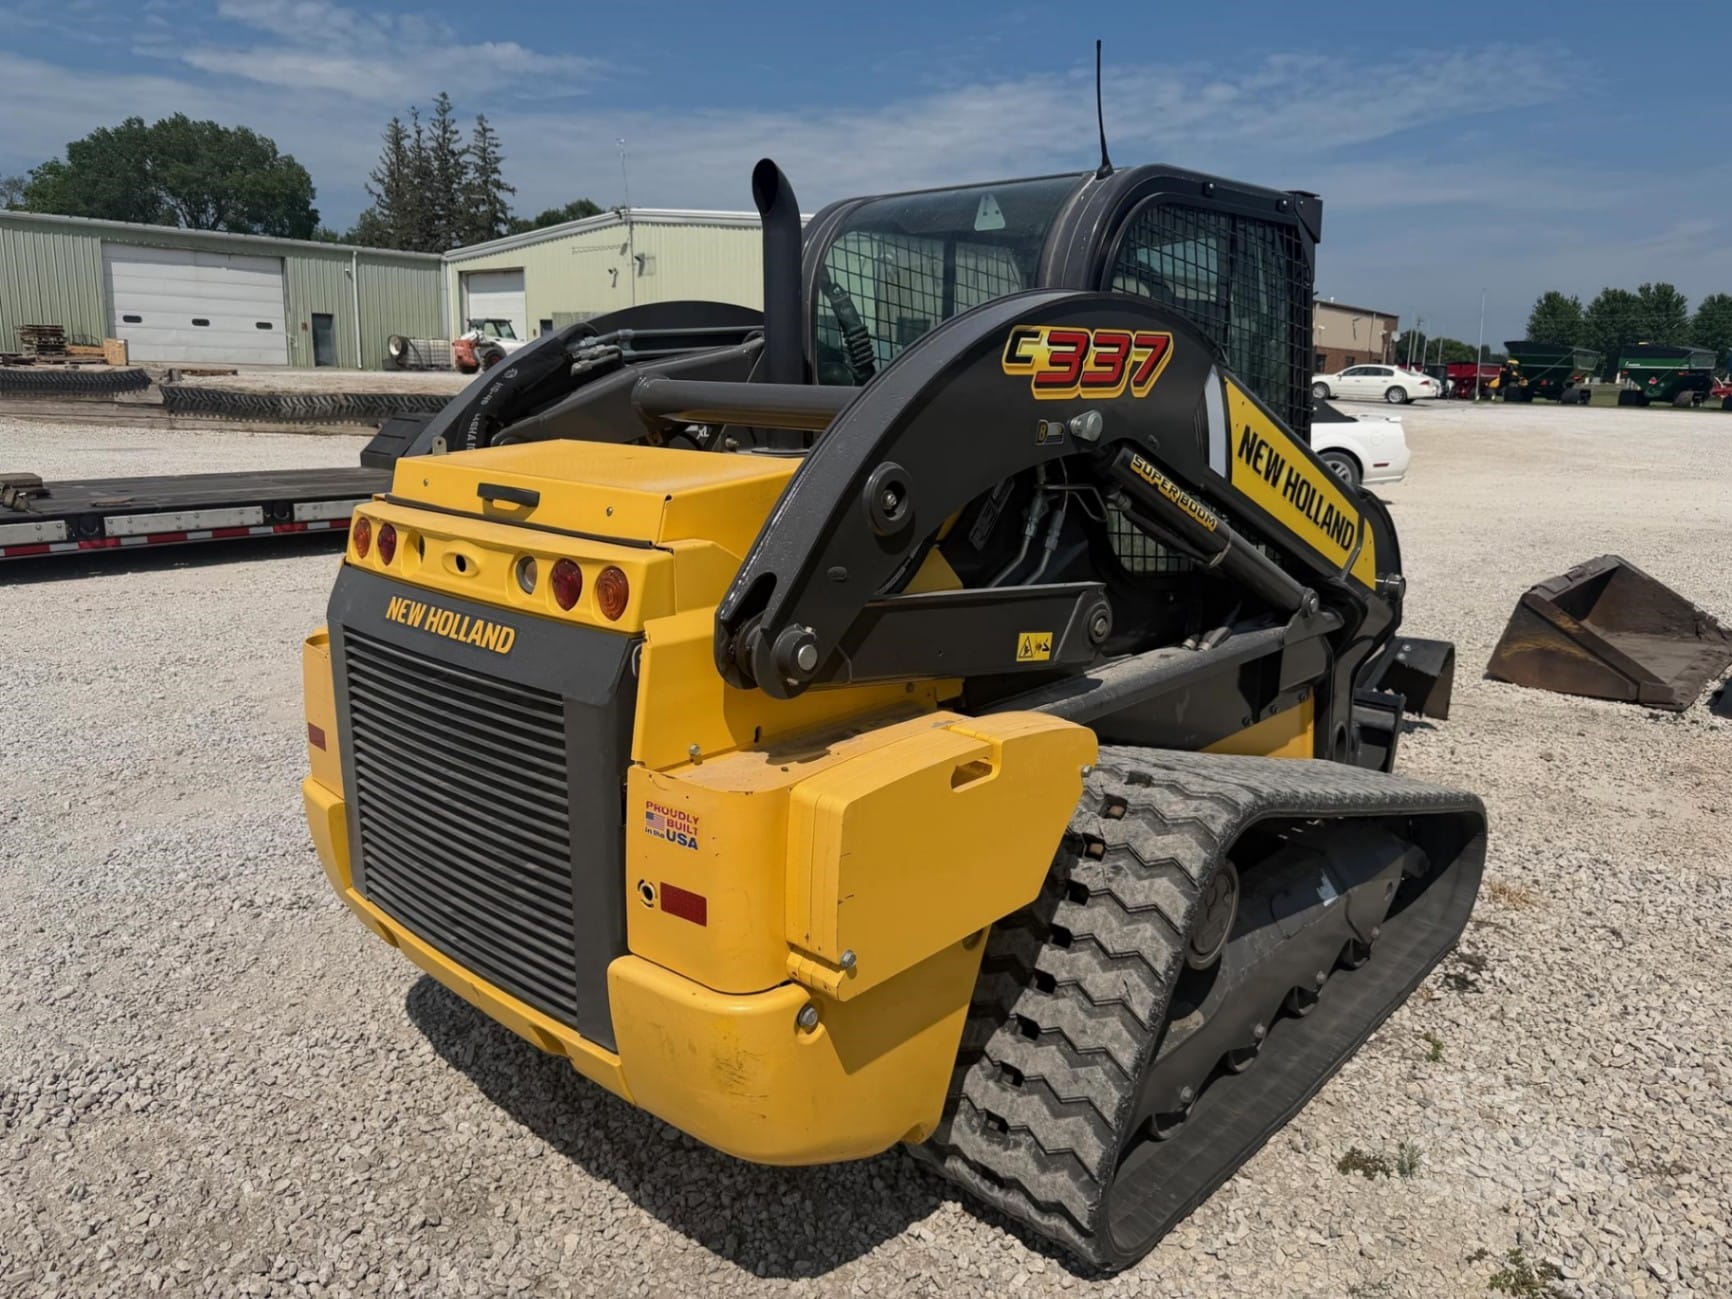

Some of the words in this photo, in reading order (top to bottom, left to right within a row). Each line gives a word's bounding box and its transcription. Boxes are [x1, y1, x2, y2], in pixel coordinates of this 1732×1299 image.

[1002, 326, 1173, 399] C337
[1131, 454, 1180, 502] SUPER
[1177, 490, 1217, 531] BOOM
[1237, 425, 1286, 489] NEW
[1282, 465, 1355, 551] HOLLAND
[385, 596, 427, 628] NEW
[423, 606, 516, 654] HOLLAND
[646, 800, 700, 825] PROUDLY
[666, 818, 698, 836] BUILT
[666, 829, 698, 850] USA
